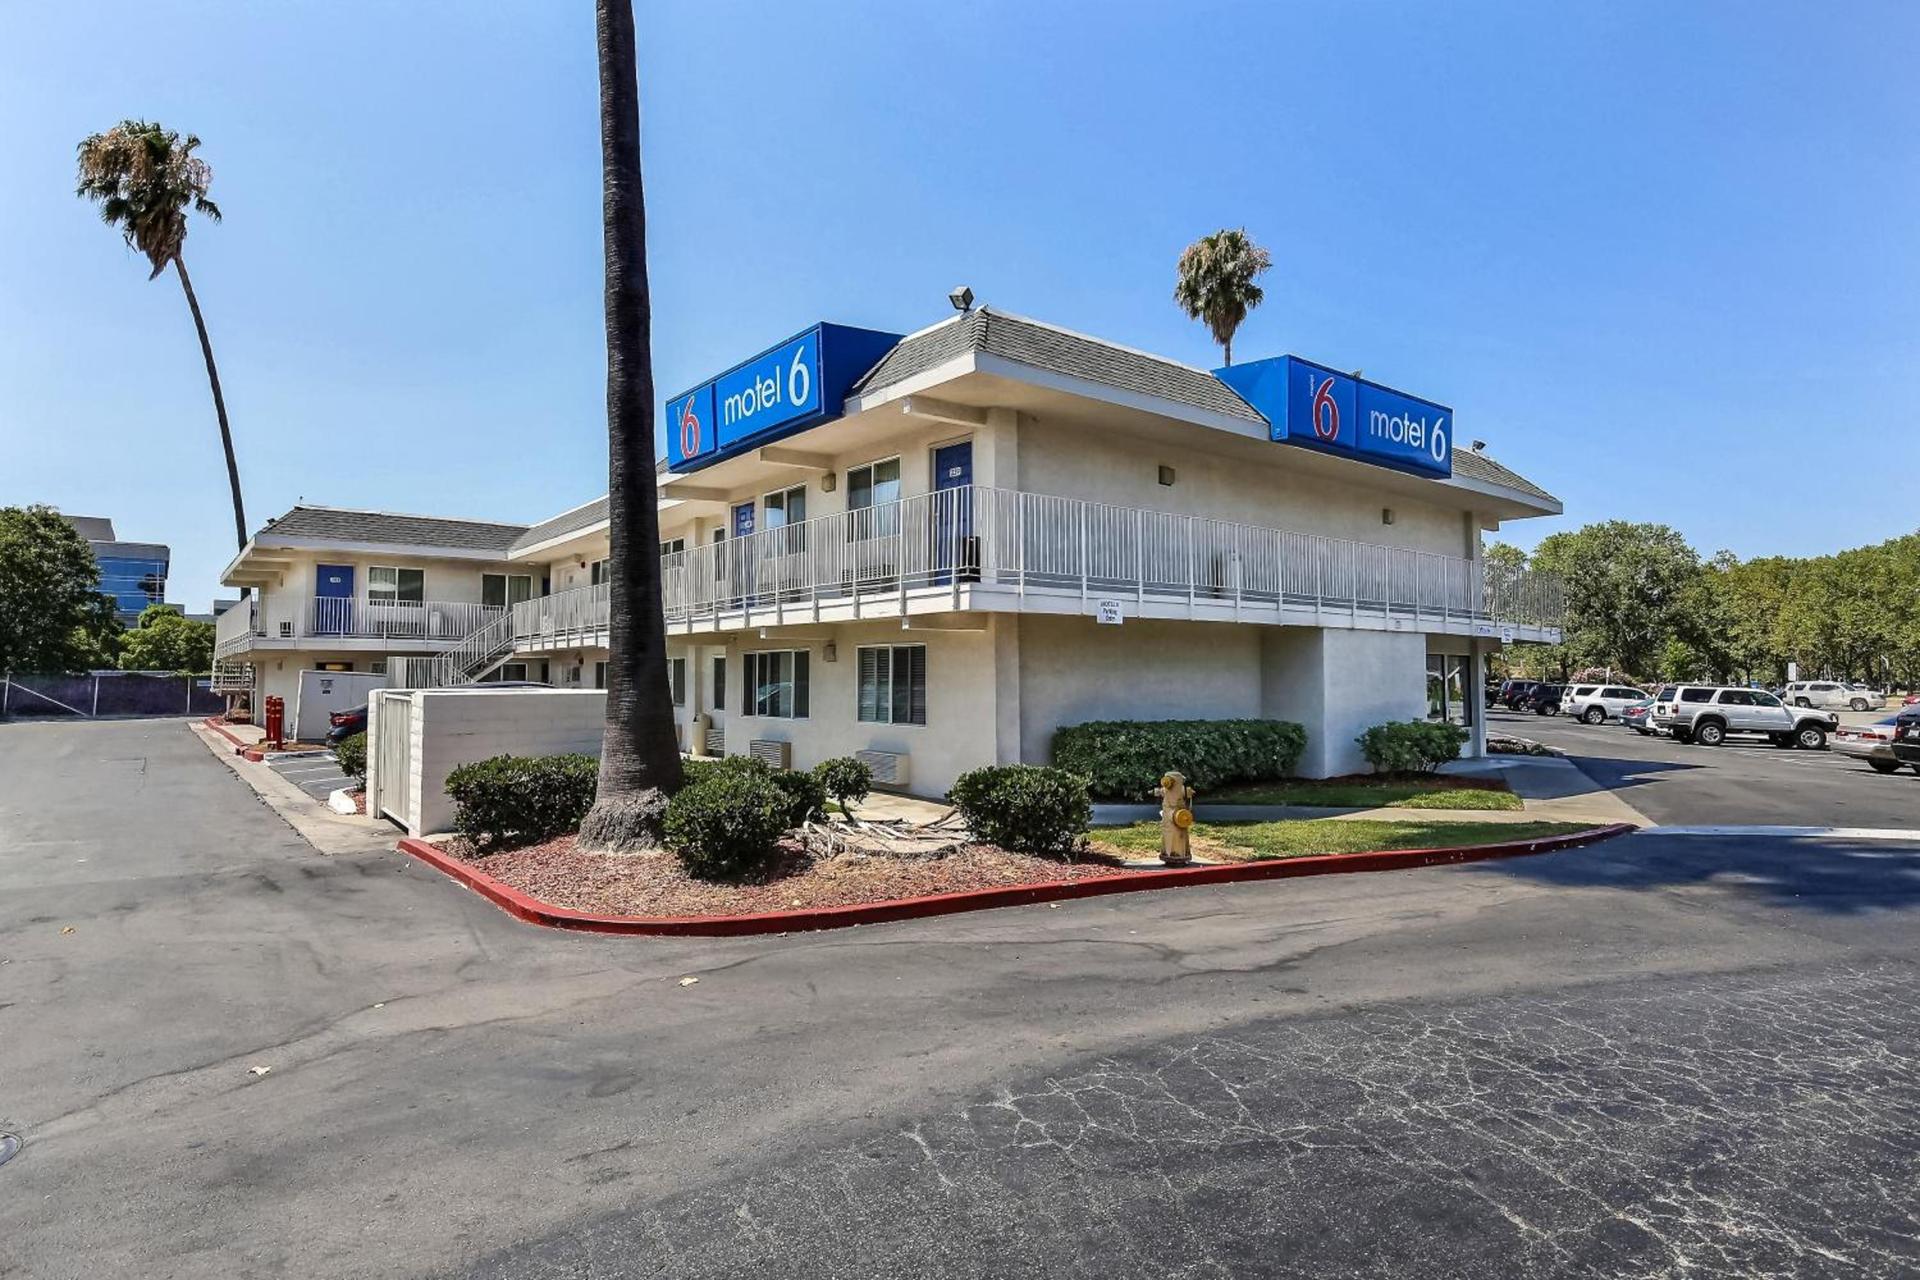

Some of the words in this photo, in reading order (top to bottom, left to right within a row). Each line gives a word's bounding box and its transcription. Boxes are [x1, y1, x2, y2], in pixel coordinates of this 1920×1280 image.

[725, 365, 781, 426] motel
[788, 345, 810, 407] 6
[1313, 377, 1339, 440] 6
[681, 396, 700, 459] 6
[1370, 409, 1425, 449] motel
[1431, 417, 1446, 463] 6
